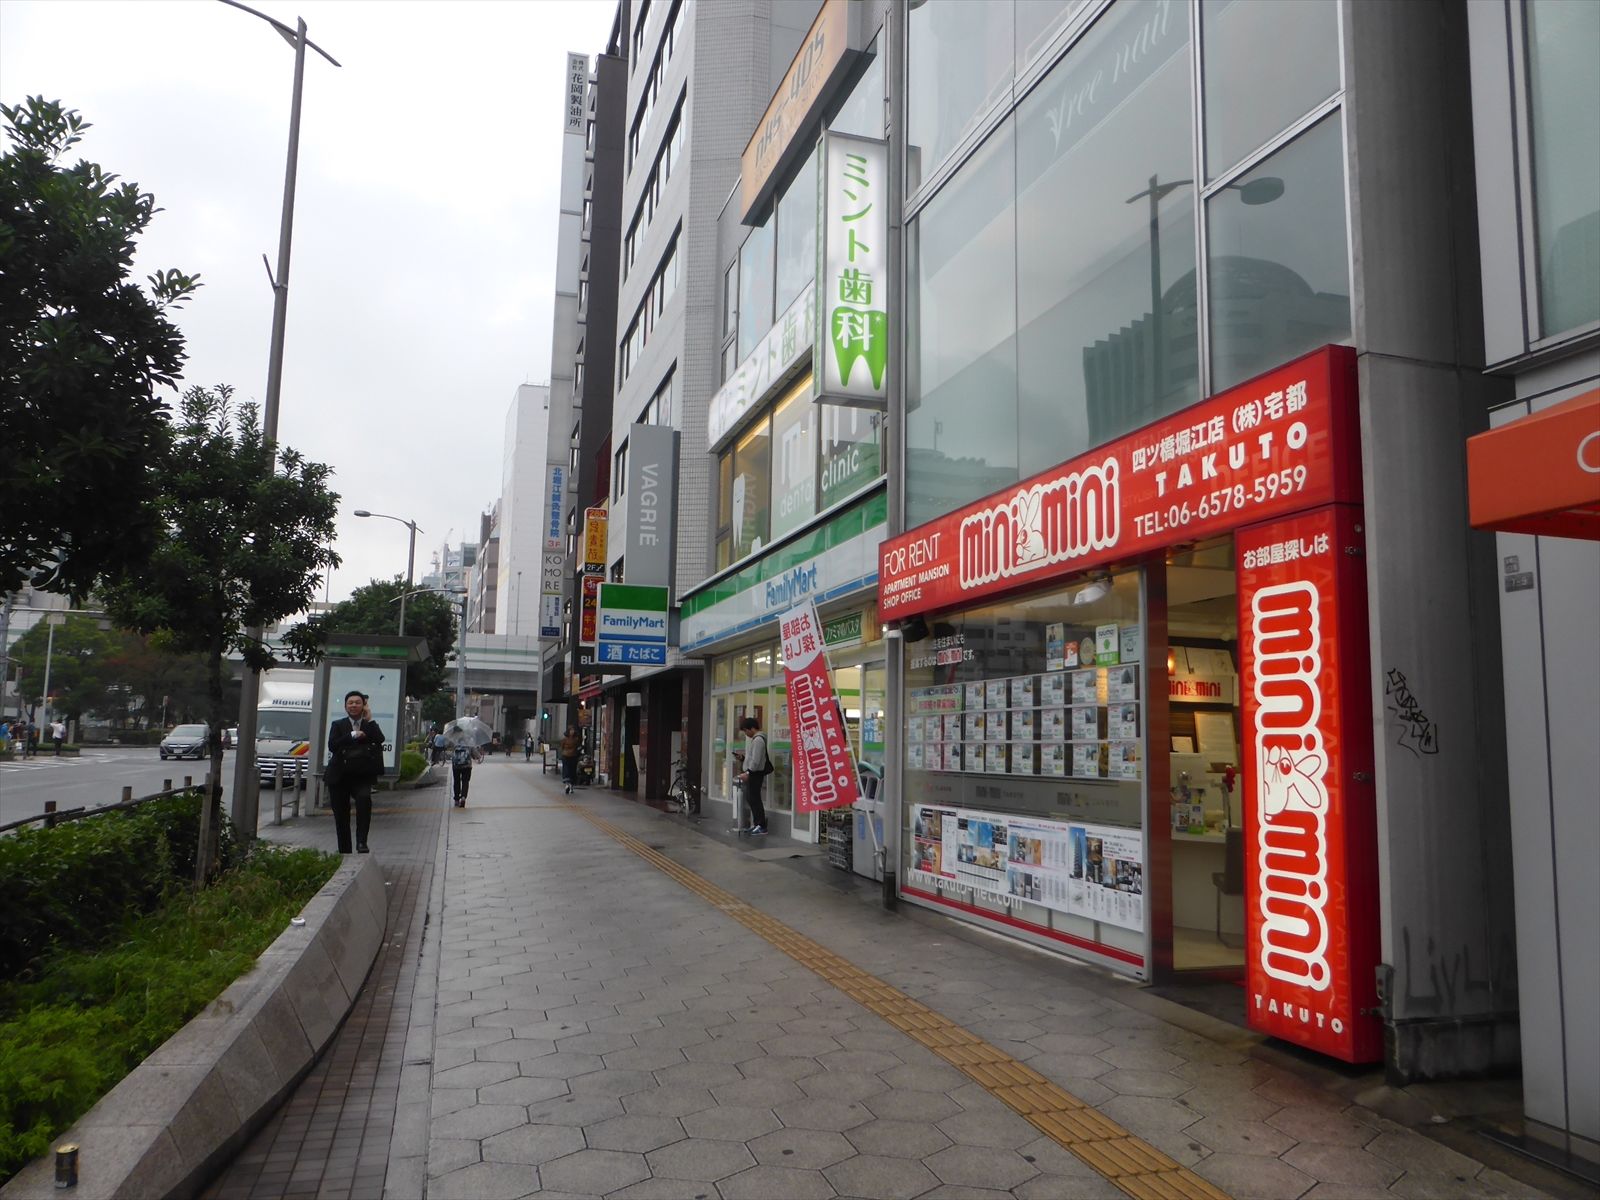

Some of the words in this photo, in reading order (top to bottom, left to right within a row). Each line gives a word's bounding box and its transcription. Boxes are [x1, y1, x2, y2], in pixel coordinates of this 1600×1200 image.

[836, 153, 874, 351] ミント歯科
[1133, 415, 1224, 473] 四ツ橋堀江店
[1232, 380, 1307, 433] (株)宅都
[821, 444, 860, 492] clinic
[1156, 421, 1307, 497] TAKUTO
[1134, 465, 1307, 537] TEL:06-6578-5959
[545, 556, 561, 565] KO
[547, 540, 560, 549] 3F
[883, 549, 905, 578] FOR
[909, 532, 941, 569] RENT
[1243, 533, 1329, 569] お部屋探しは
[545, 569, 561, 577] MO
[545, 581, 559, 590] RE
[765, 562, 817, 609] FamilyMart
[883, 574, 916, 595] APARTMENT
[918, 563, 950, 584] MANSION
[883, 594, 900, 609] SHOP
[900, 588, 922, 605] OFFICE
[603, 614, 665, 631] FamilyMart
[607, 644, 623, 661] 酒
[628, 646, 660, 661] たばこ
[1254, 994, 1344, 1034] TAKUTO
